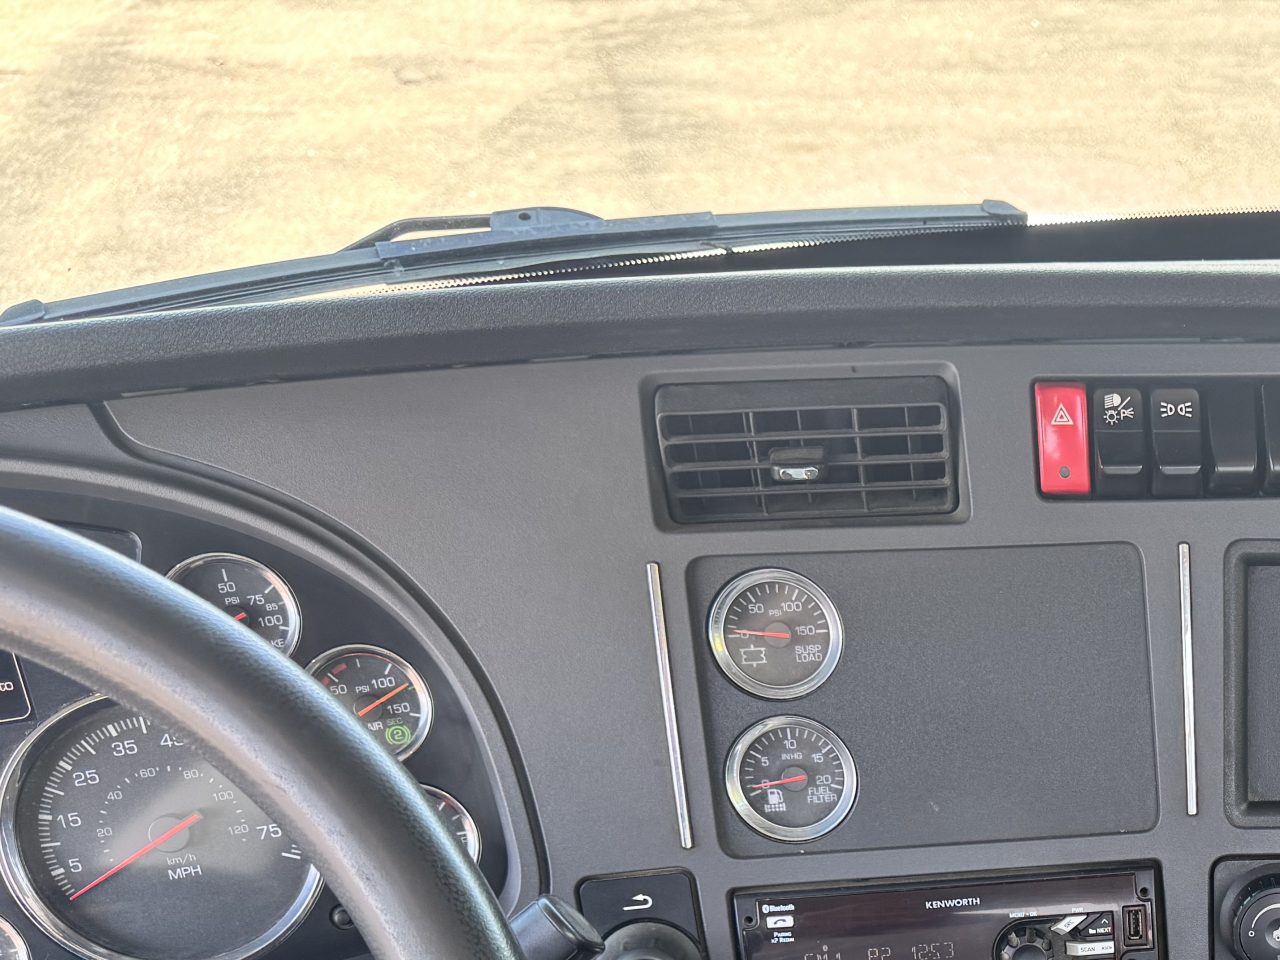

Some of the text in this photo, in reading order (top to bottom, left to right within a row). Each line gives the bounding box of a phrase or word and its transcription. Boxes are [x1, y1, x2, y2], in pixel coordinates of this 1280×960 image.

[218, 581, 236, 593] 50
[225, 597, 240, 605] PSI
[246, 594, 265, 606] 75
[749, 603, 764, 614] 50
[769, 608, 782, 616] PSI
[781, 601, 803, 612] 100
[258, 614, 283, 627] 100
[795, 625, 815, 636] 150
[795, 644, 821, 654] SUSP
[796, 653, 823, 663] LOAD
[371, 676, 396, 689] 100
[330, 684, 348, 695] 50
[355, 685, 370, 694] PSI
[386, 702, 411, 714] 150
[111, 740, 138, 757] 35
[783, 739, 797, 749] 10
[761, 756, 770, 767] 5
[812, 753, 824, 763] 15
[73, 769, 100, 787] 25
[140, 767, 155, 778] 60
[183, 769, 198, 779] 80
[816, 774, 831, 785] 20
[106, 790, 122, 801] 40
[212, 790, 234, 802] 100
[808, 786, 833, 796] FUEL
[807, 794, 838, 804] FILTER
[57, 812, 82, 829] 15
[96, 826, 112, 838] 20
[228, 823, 249, 836] 120
[256, 823, 282, 840] 75
[166, 853, 196, 865] km/h
[68, 858, 82, 873] 5
[167, 864, 202, 881] MPH
[925, 897, 980, 910] KENWORTH
[1096, 926, 1112, 934] NEXT
[911, 941, 954, 960] 12:53
